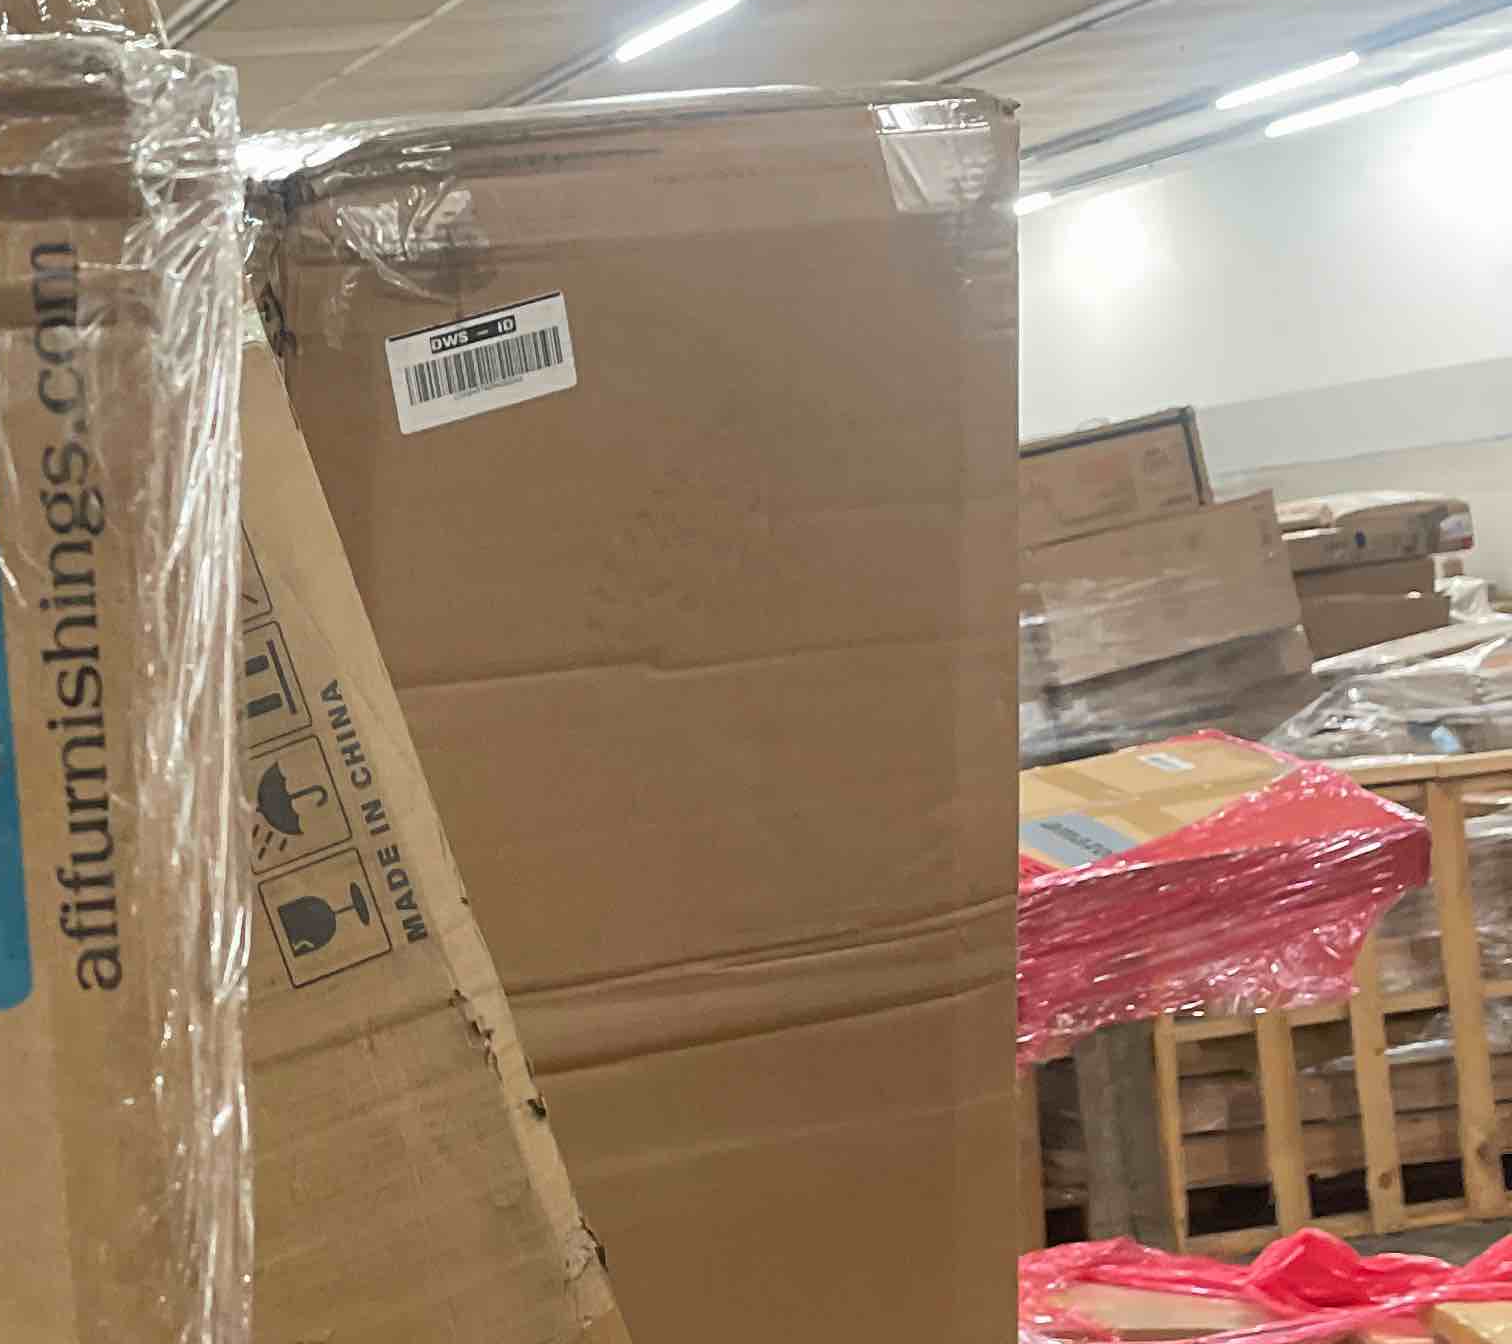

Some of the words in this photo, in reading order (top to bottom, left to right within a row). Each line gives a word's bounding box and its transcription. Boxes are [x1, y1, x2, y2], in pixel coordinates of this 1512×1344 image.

[431, 331, 469, 351] DWS
[28, 241, 123, 993] afifurnishings.com
[319, 679, 373, 790] CHINA
[360, 798, 391, 837] IN
[377, 844, 429, 944] MADE
